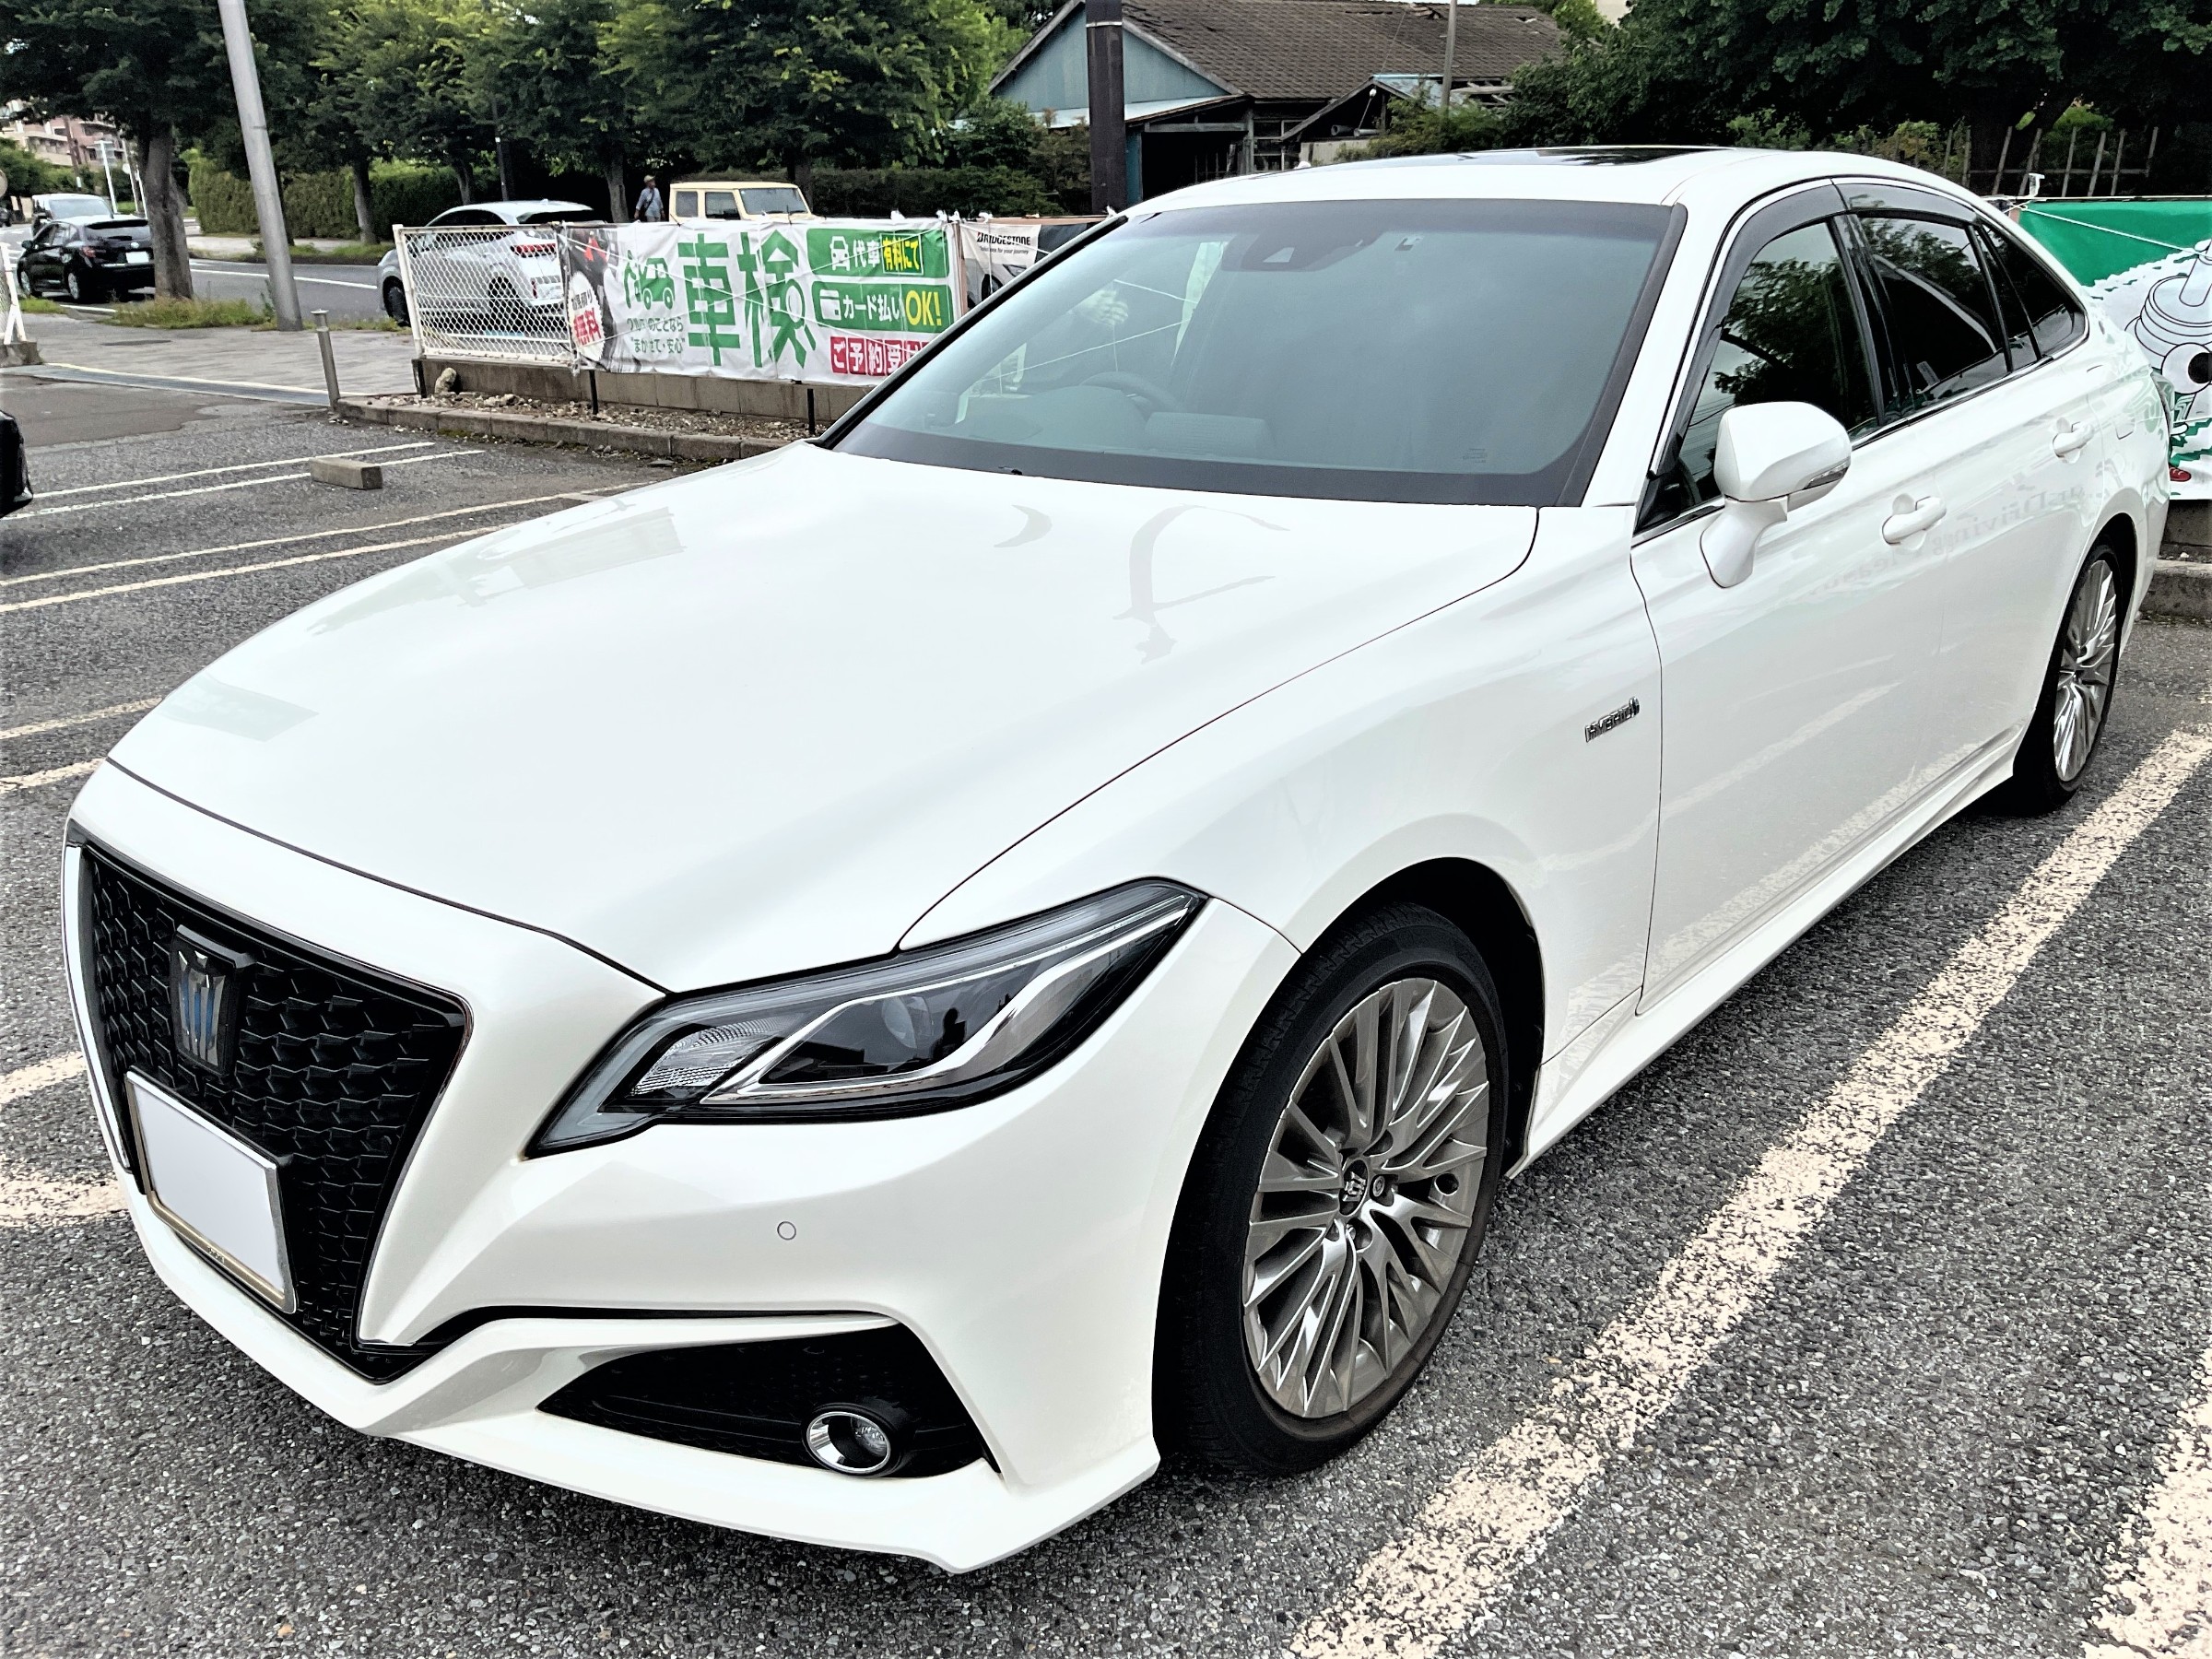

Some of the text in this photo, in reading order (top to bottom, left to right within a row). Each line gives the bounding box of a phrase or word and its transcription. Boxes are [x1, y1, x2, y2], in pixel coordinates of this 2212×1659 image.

[977, 232, 1030, 245] BRIDGESTONE
[677, 229, 817, 369] 車検
[842, 289, 942, 325] カード払い OK!
